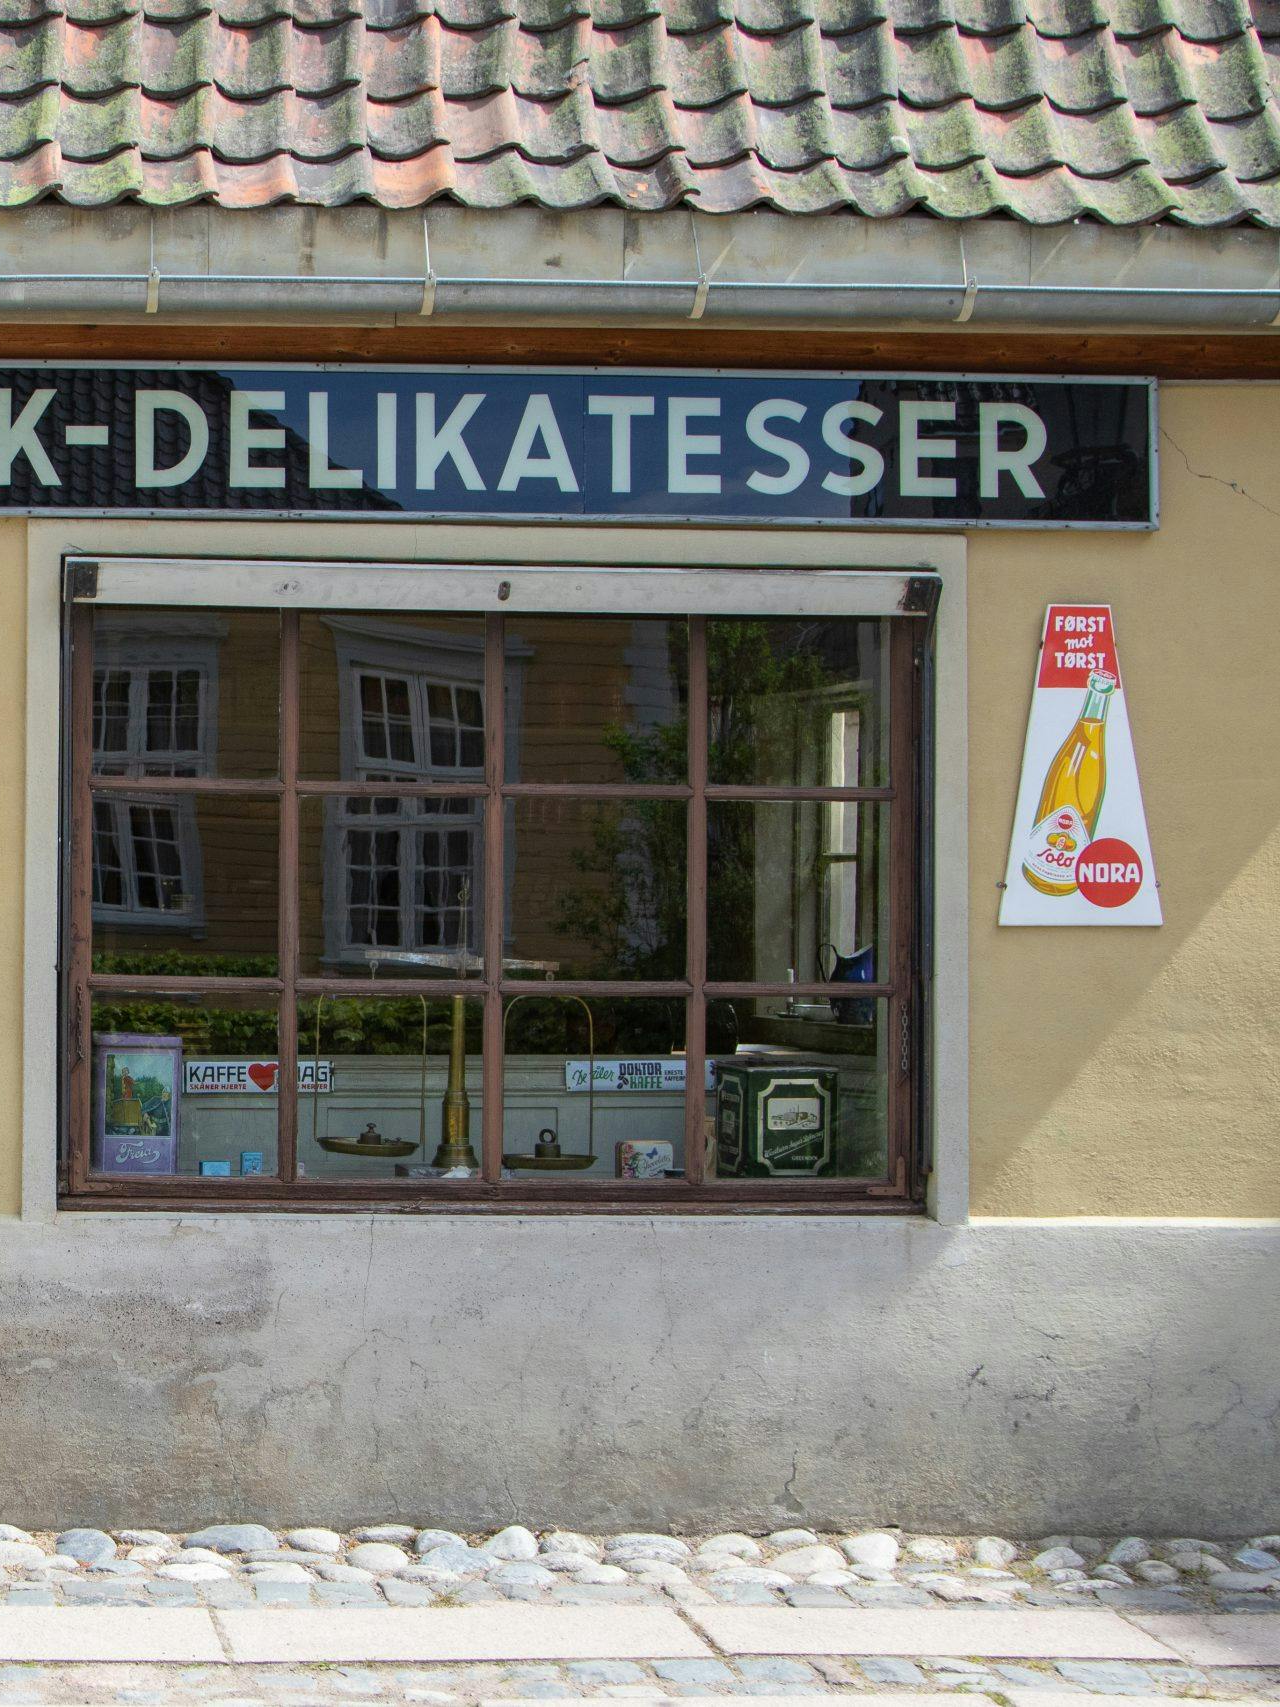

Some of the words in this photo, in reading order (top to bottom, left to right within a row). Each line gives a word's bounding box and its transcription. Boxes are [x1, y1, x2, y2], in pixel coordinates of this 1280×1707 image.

[1054, 615, 1106, 633] FØRST
[1064, 635, 1094, 650] mot
[1054, 651, 1106, 670] TØRST
[1036, 848, 1075, 868] Solo
[1079, 862, 1140, 883] NORA
[189, 1066, 246, 1082] KAFFE
[619, 1062, 662, 1075] DOKTOR
[190, 1082, 219, 1090] SKÅNER
[630, 1075, 663, 1089] KAFFE
[115, 1141, 160, 1163] Freia
